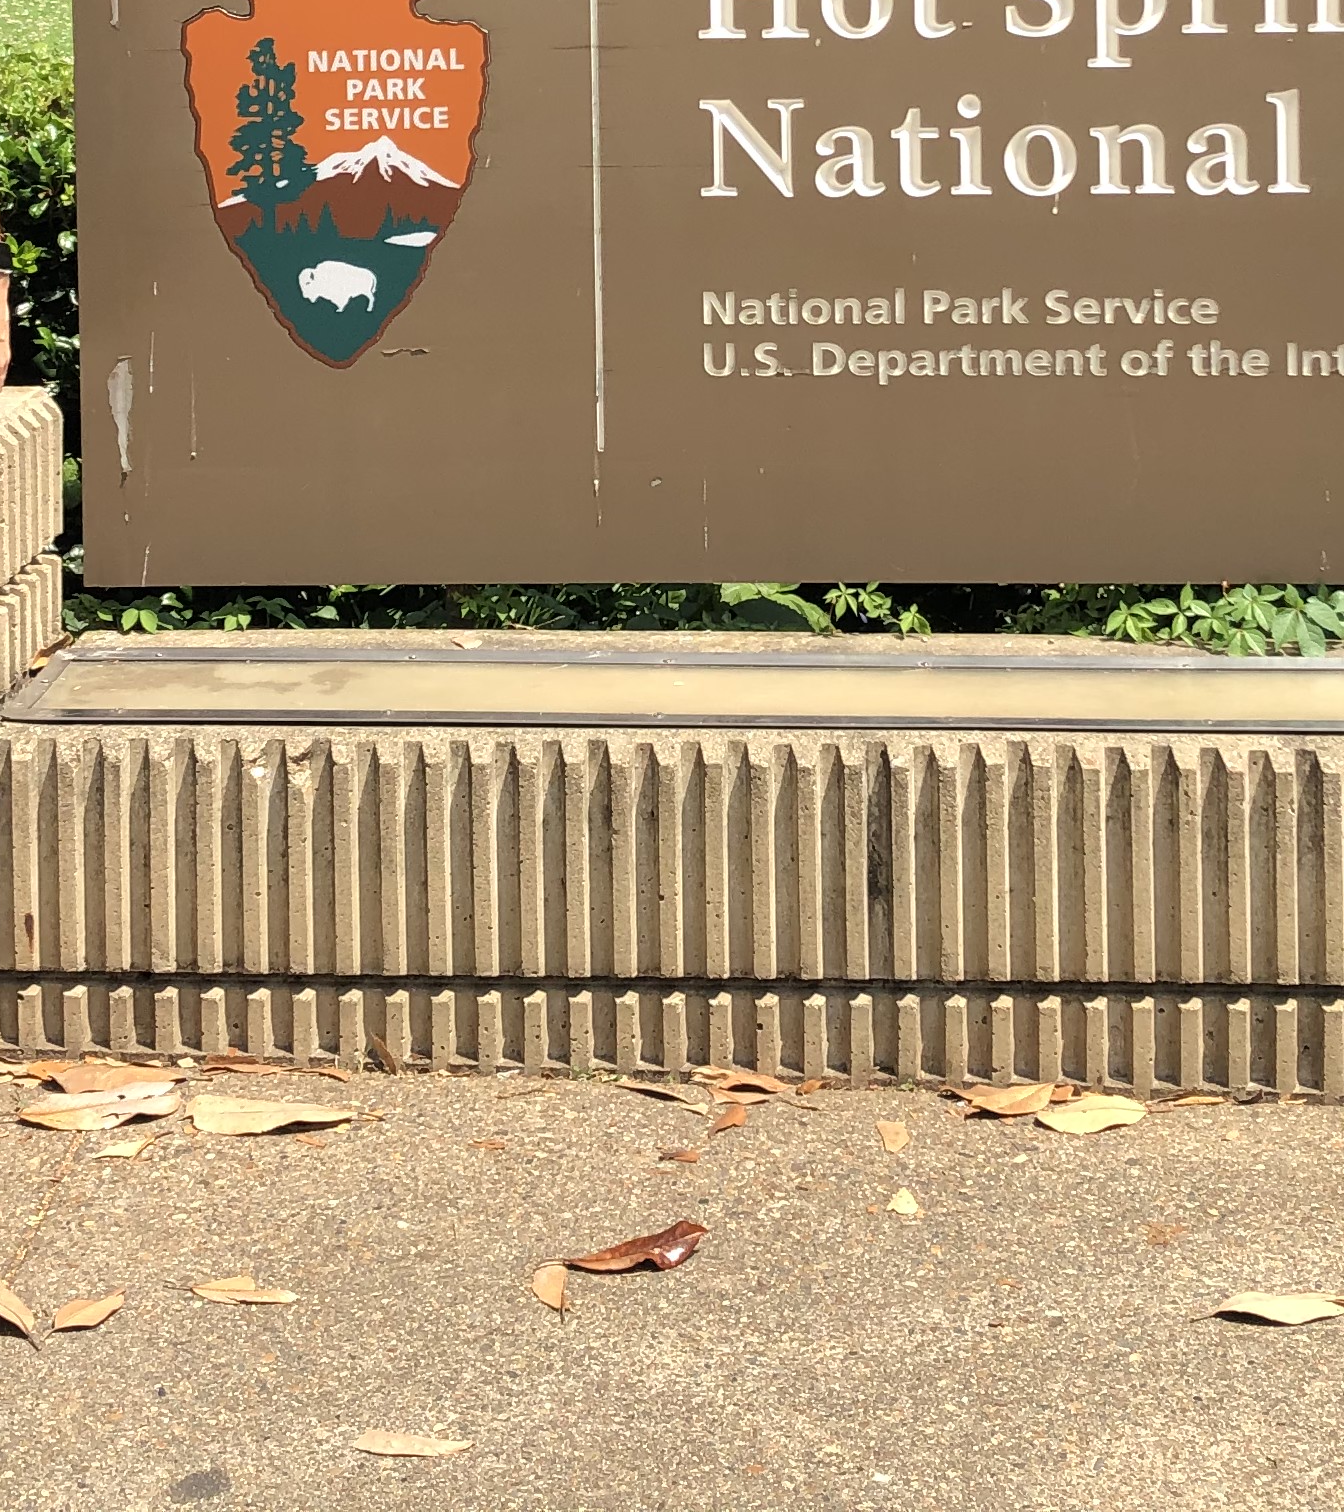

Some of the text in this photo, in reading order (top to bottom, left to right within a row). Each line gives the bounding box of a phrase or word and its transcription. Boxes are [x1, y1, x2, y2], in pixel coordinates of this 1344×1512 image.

[307, 48, 465, 73] NATIONAL
[346, 77, 426, 101] PARK
[324, 106, 449, 131] SERVICE
[699, 89, 1311, 198] National
[702, 287, 1219, 325] National Park Service
[703, 342, 793, 377] U.S.
[812, 341, 1108, 385] Department
[1120, 339, 1174, 377] of
[1186, 339, 1270, 377] the
